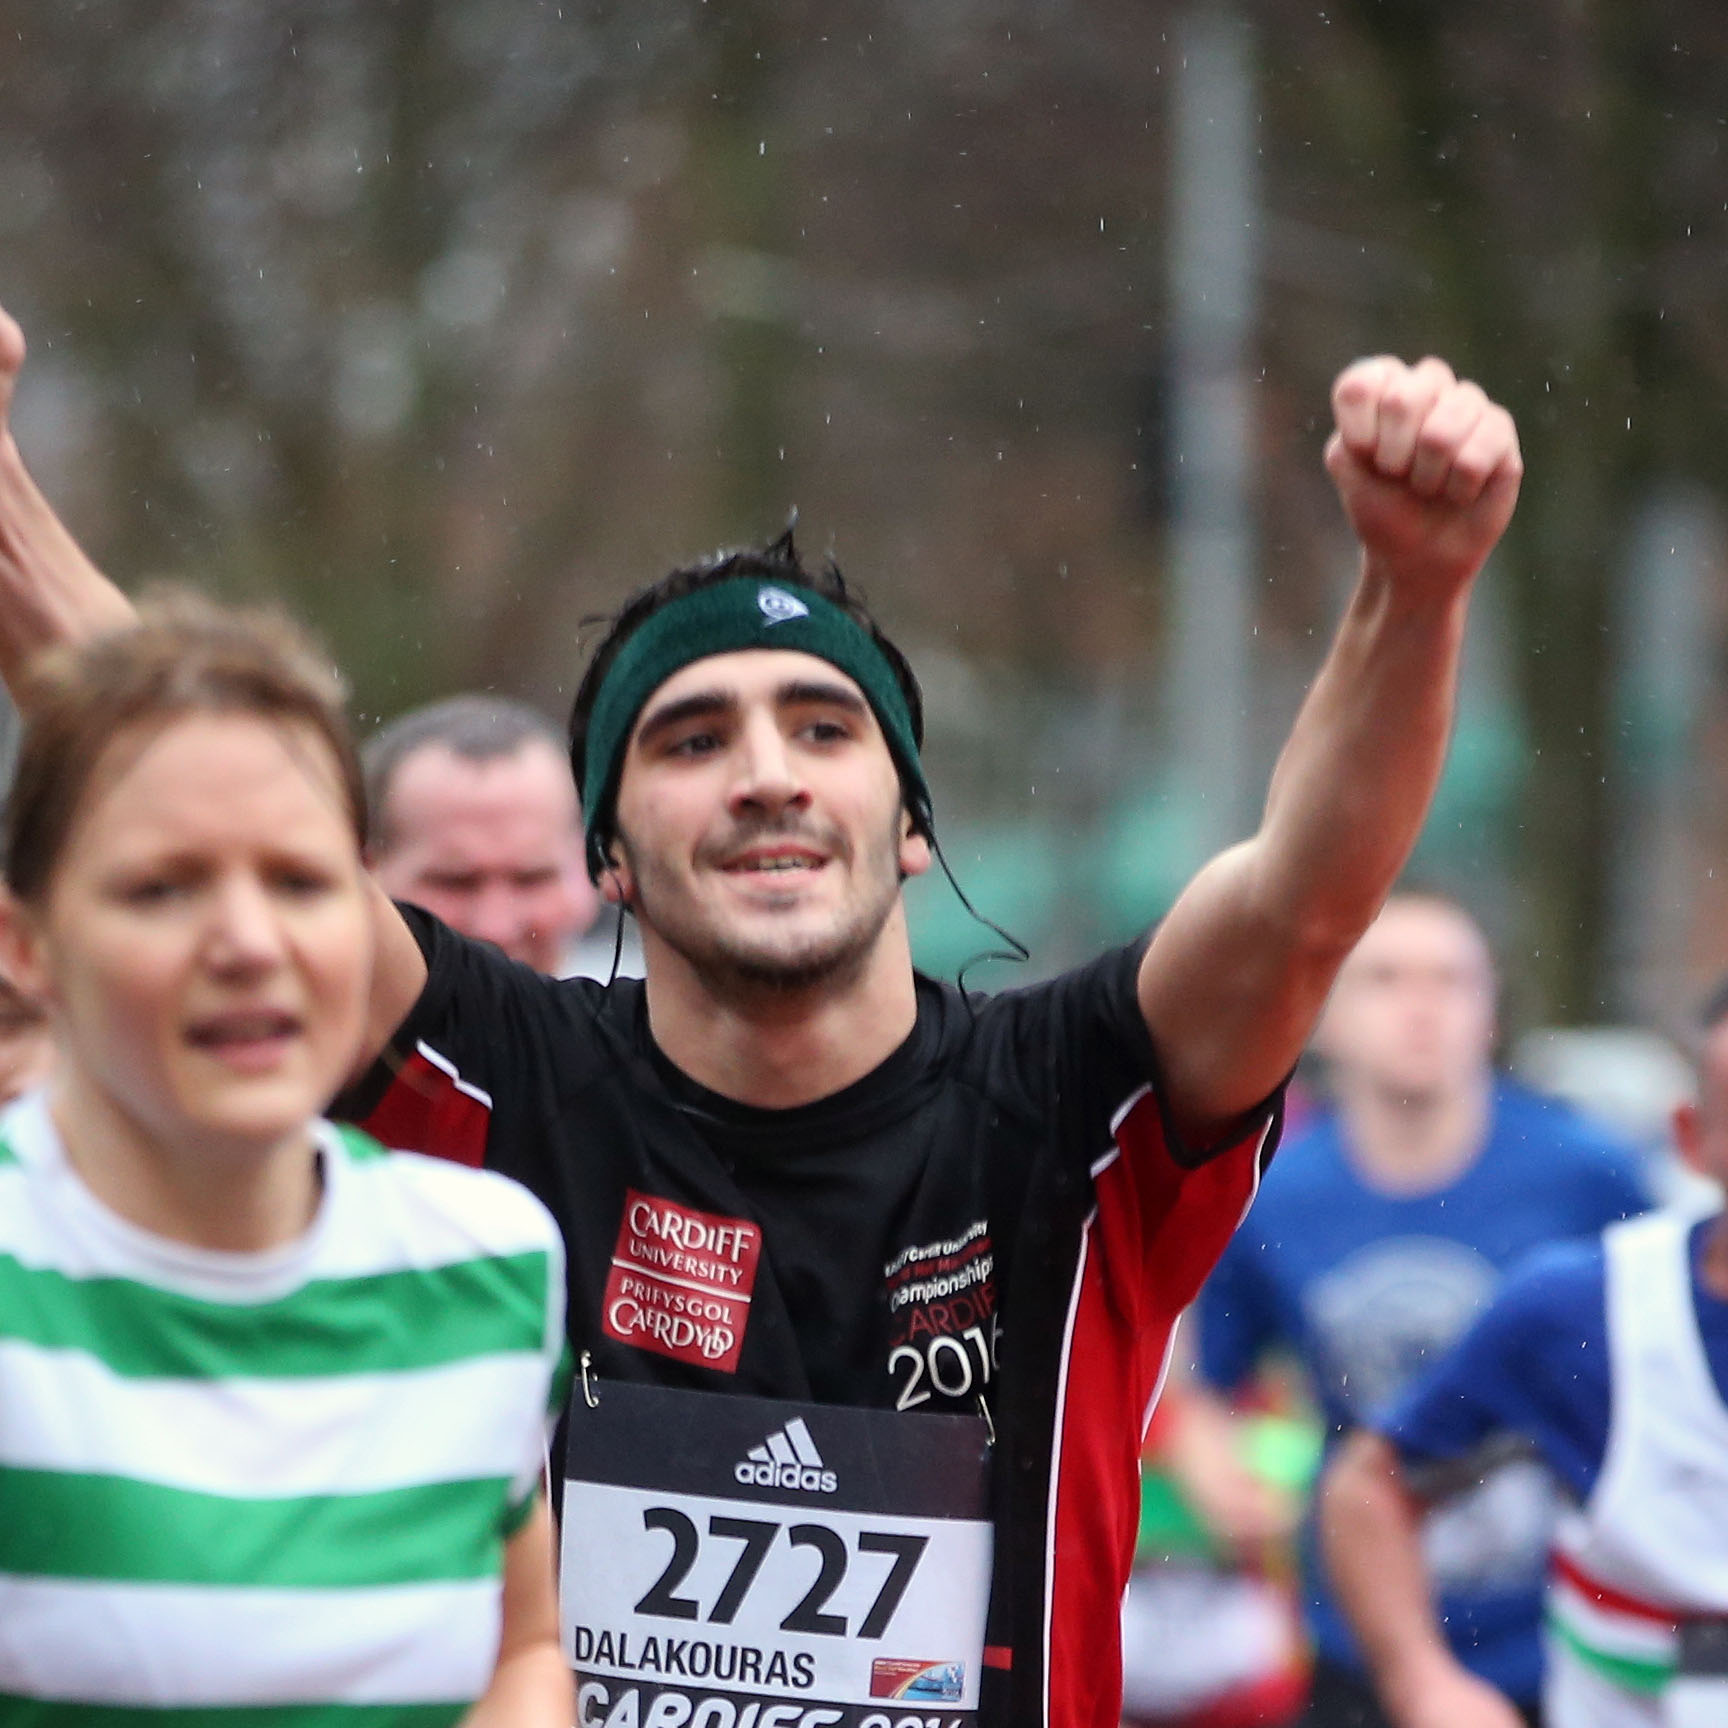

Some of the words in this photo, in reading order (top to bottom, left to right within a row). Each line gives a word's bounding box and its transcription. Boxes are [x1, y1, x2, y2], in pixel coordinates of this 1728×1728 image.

[629, 1202, 755, 1264] CARDIFF
[629, 1238, 743, 1286] UNIVERSITY
[622, 1278, 734, 1325] PRIFYSGOL
[734, 1460, 839, 1493] adidas
[633, 1508, 931, 1640] 2727
[574, 1626, 816, 1690] DALAKOURAS
